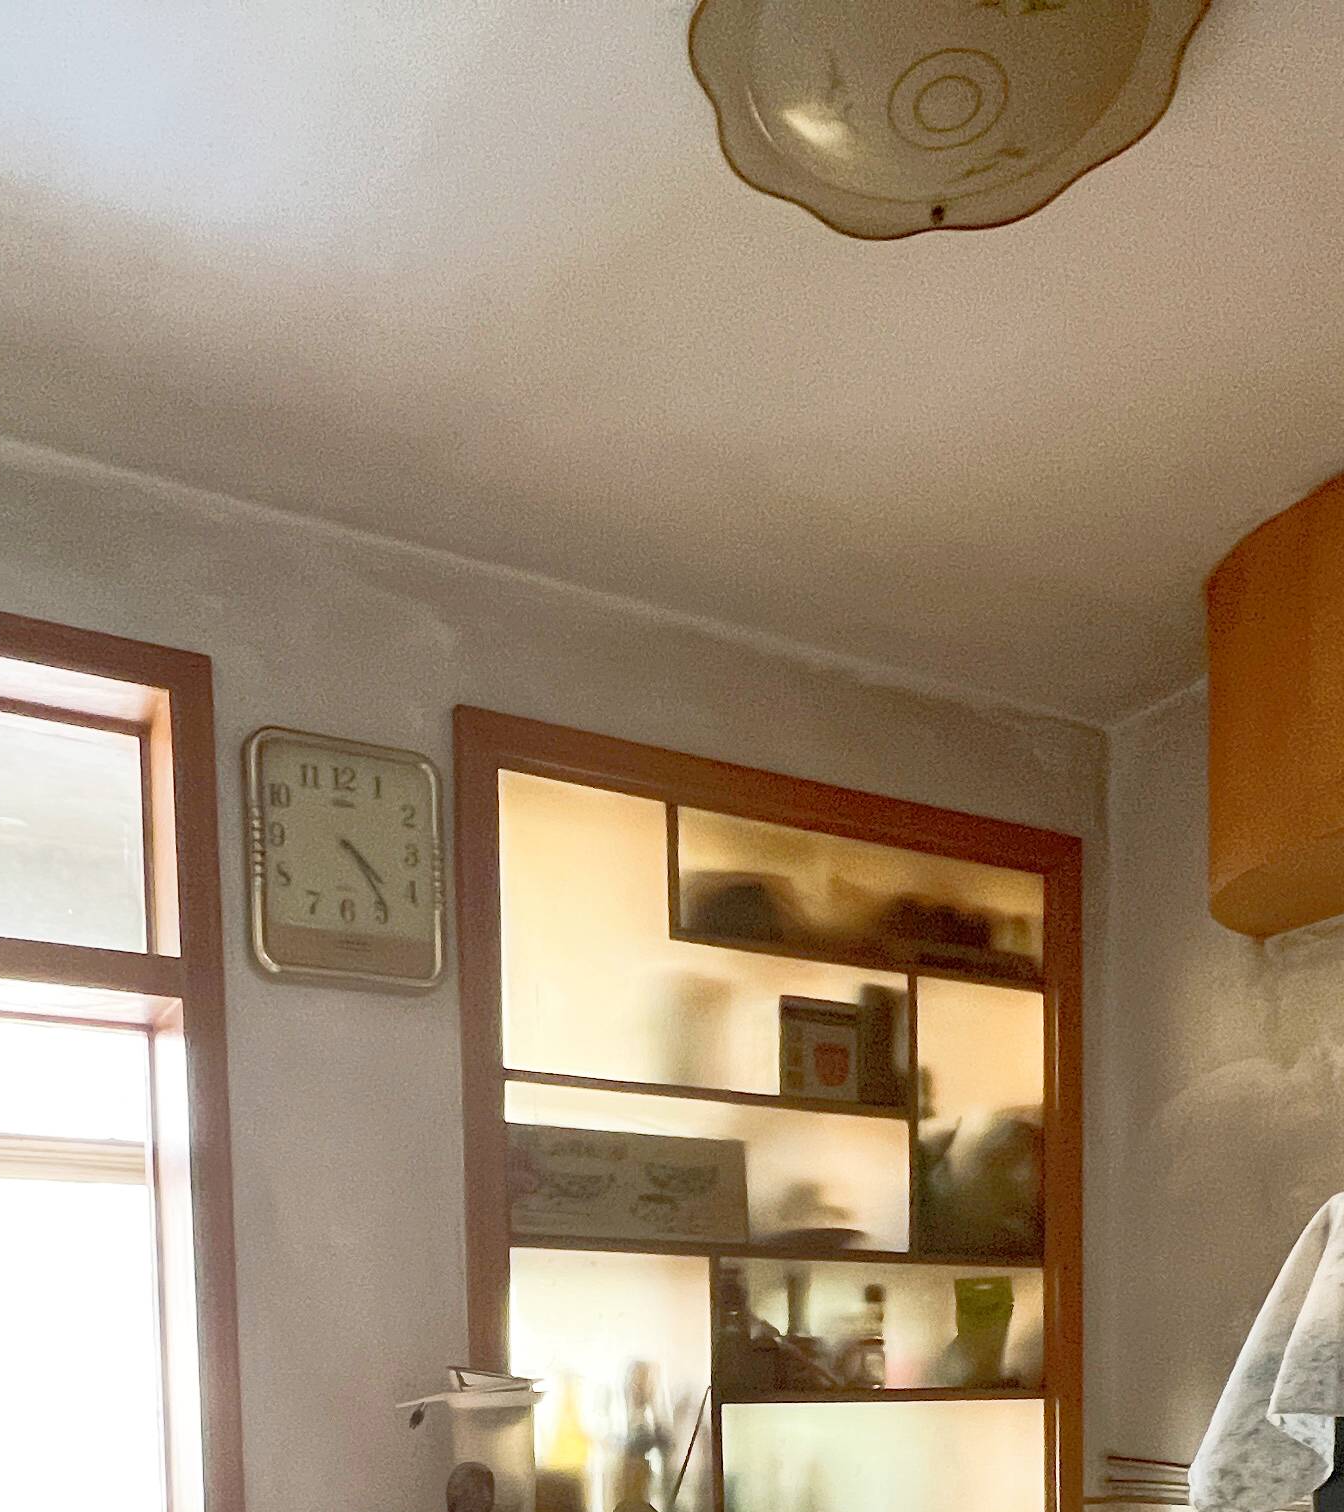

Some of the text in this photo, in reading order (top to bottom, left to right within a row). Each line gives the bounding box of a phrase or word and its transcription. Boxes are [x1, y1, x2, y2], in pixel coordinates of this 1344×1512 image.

[301, 765, 318, 789] 11
[332, 768, 356, 792] 12
[373, 777, 383, 799] 1
[270, 784, 291, 808] 10
[401, 806, 416, 829] 2
[270, 823, 286, 847] 9
[405, 845, 419, 868] 3
[307, 892, 322, 915] 7
[341, 899, 355, 922] 6
